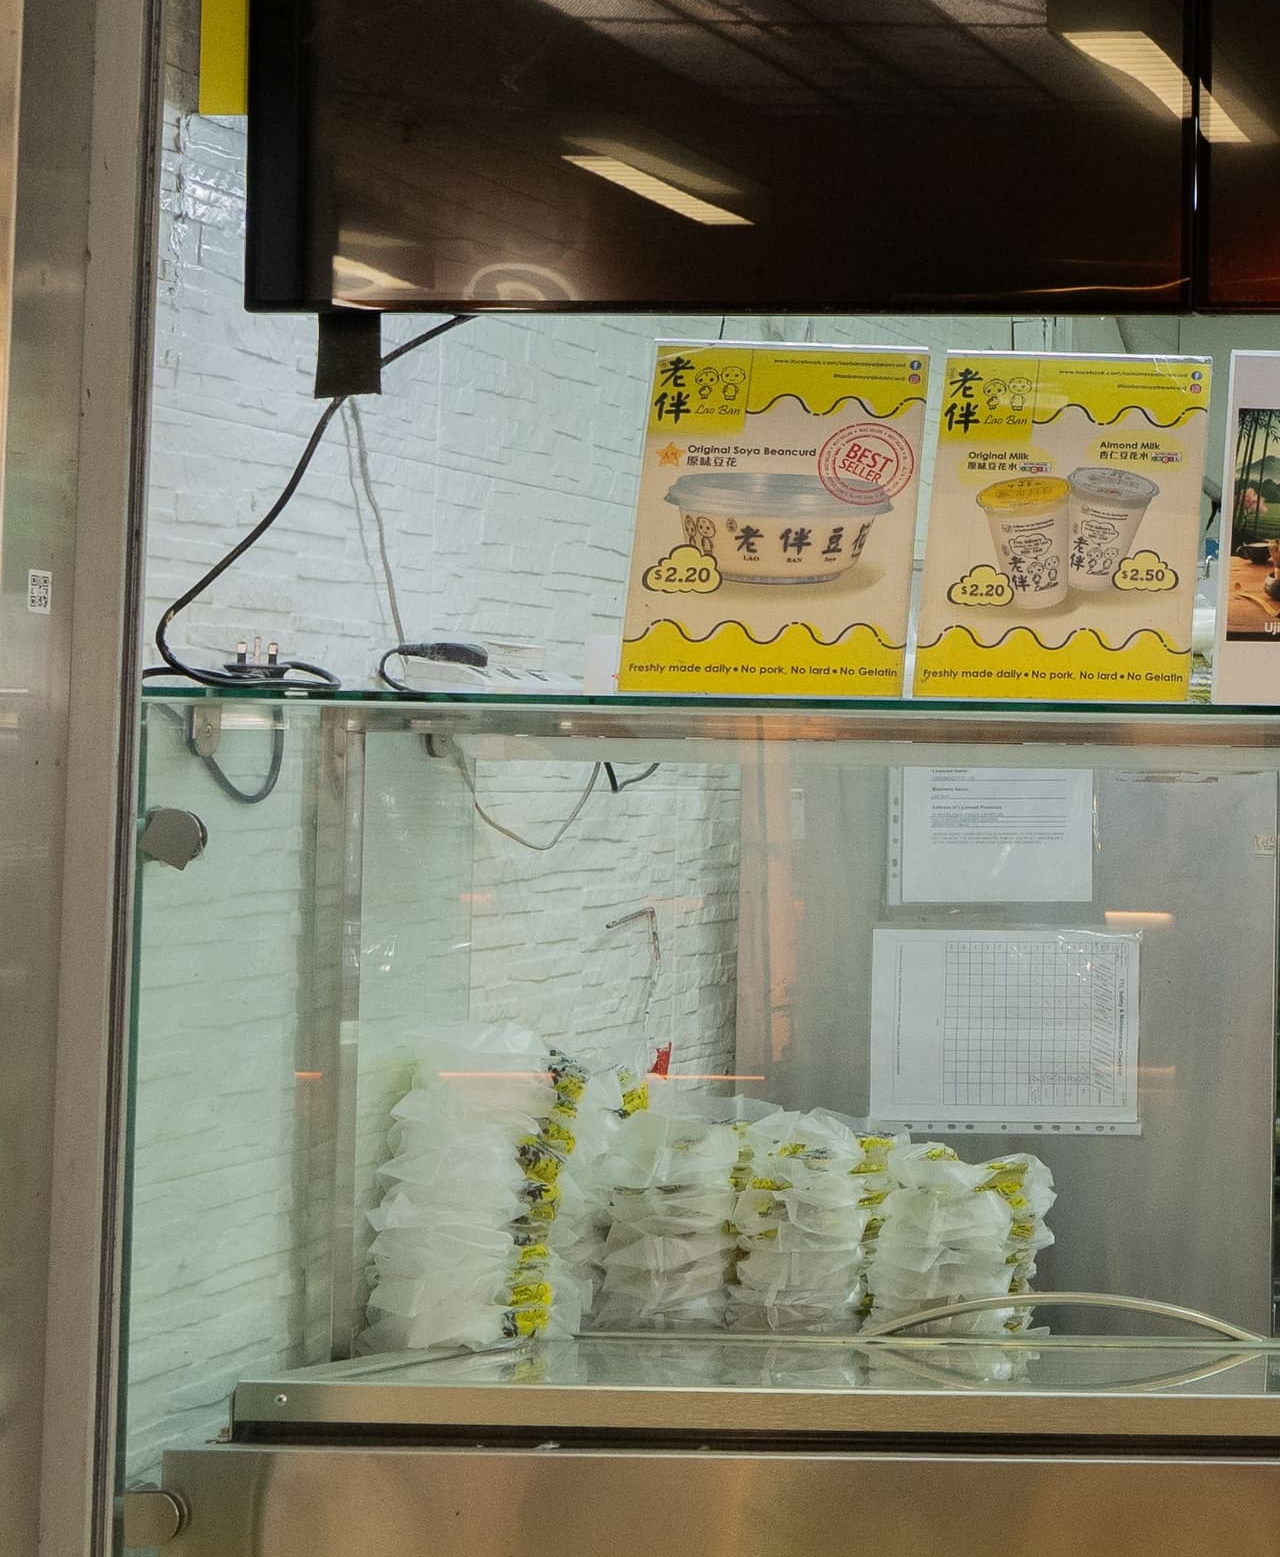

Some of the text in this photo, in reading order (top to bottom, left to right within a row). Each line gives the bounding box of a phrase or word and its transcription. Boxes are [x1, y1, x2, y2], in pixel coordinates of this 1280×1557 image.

[654, 357, 695, 424] 老伴
[944, 368, 983, 433] 老伴
[688, 445, 816, 458] Original Soya Beancurd
[1100, 441, 1160, 451] Almond Milk
[846, 443, 893, 472] BEST
[968, 451, 1029, 461] Original Milk
[839, 458, 881, 483] SELLER
[654, 566, 711, 583] $2.20
[1122, 569, 1165, 582] $2.50
[961, 584, 1005, 597] $2.20
[629, 663, 666, 674] Freshly
[669, 664, 701, 673] made
[704, 664, 731, 675] daily
[741, 665, 756, 674] No
[791, 666, 807, 675] No
[809, 666, 830, 675] lard
[840, 667, 855, 676] No
[858, 667, 897, 677] Gelatin
